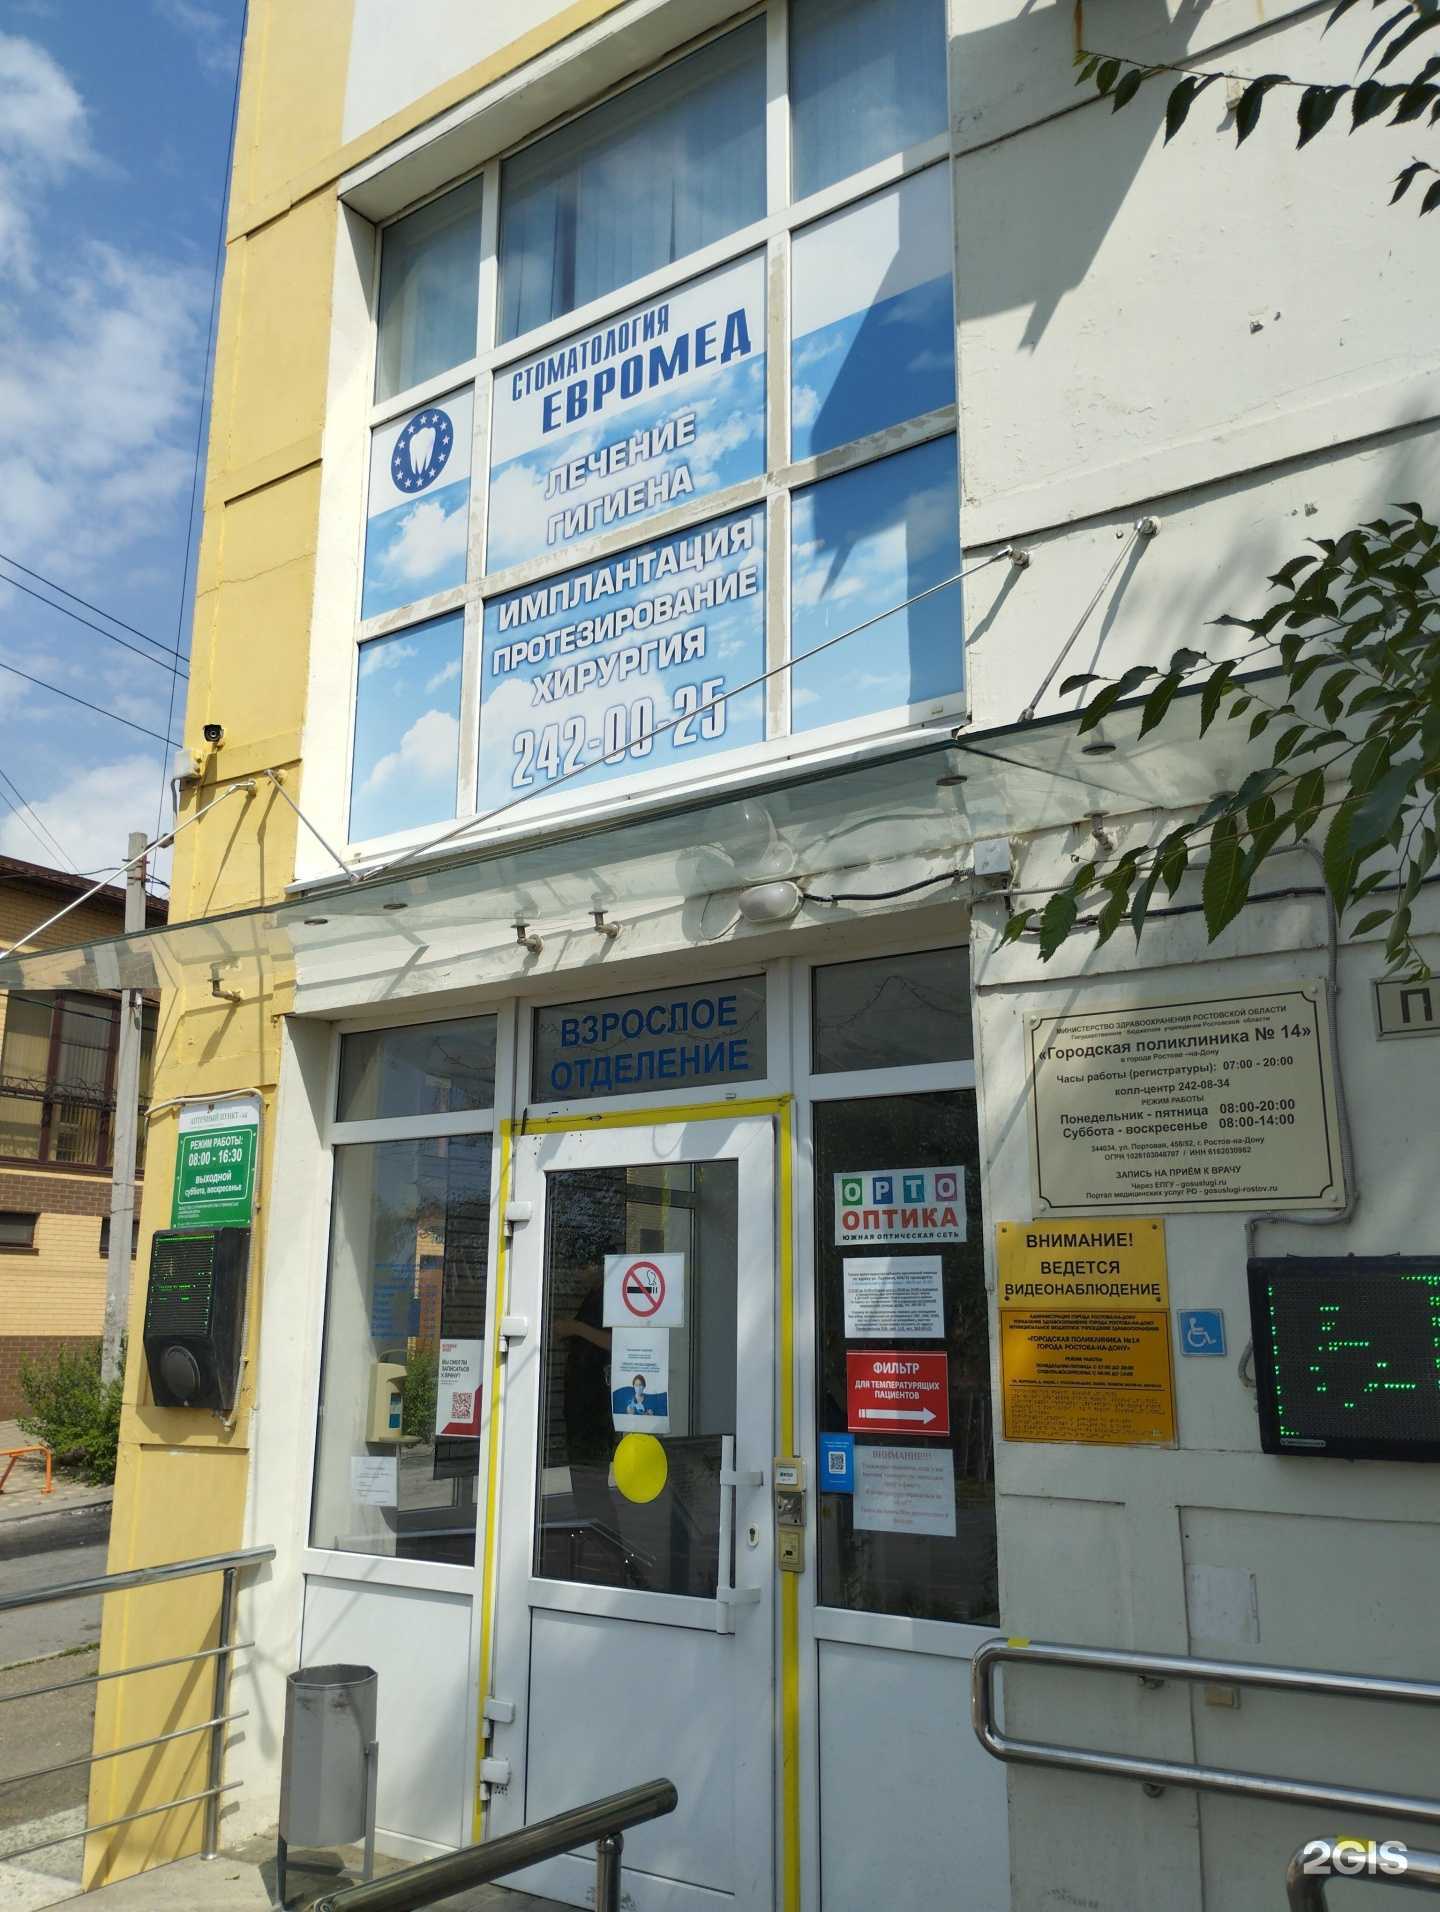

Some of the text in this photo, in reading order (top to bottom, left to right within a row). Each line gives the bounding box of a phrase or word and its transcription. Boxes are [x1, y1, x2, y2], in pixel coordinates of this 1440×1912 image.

[512, 304, 669, 402] СТОМАТОЛОГИЯ
[542, 308, 752, 434] ЕВРОМЕД
[544, 413, 697, 500] ЛЕЧЕНИЕ
[547, 467, 694, 545] ГИГИЕНА
[498, 517, 754, 631] ИМПЛАНТАЦИЯ
[493, 567, 758, 675] ПРОТЕЗИРОВАНИЕ
[532, 627, 706, 706] ХИРУРГИЯ
[512, 678, 726, 788] 242-00-25
[560, 996, 737, 1049] ВЗРОСЛОЕ
[1057, 1005, 1287, 1034] МИНИСТЕРСТВО ЗДРАВООХРАНЕНИЯ РОСТОВСКОЙ ОБЛАСТИ
[1039, 1024, 1312, 1062] «Городская поликлиника № 14»
[550, 1039, 749, 1092] ОТДЕЛЕНИЕ
[1056, 1074, 1084, 1084] Часы
[1087, 1071, 1127, 1083] работы
[1129, 1063, 1217, 1080] (регистратуры):
[1223, 1059, 1253, 1071] 07:00
[1263, 1056, 1294, 1067] 20:00
[1114, 1078, 1230, 1096] колл-центр 242-08-34
[1171, 1095, 1204, 1104] РАБОТЫ
[1060, 1111, 1144, 1125] Понедельник
[1155, 1106, 1209, 1120] пятница
[1219, 1098, 1295, 1114] 08:00-20:00
[1063, 1127, 1115, 1141] Суббота
[1126, 1121, 1209, 1136] воскресенье
[1218, 1114, 1295, 1128] 08:00-14:00
[190, 1136, 243, 1150] РЕЖИМ РАБОТЫ:
[1204, 1137, 1265, 1146] Ростов-на-Дону
[188, 1152, 211, 1166] 08:00
[219, 1148, 242, 1163] 16:30
[1105, 1152, 1125, 1160] ОГРН
[1190, 1148, 1206, 1156] ИНН
[1116, 1170, 1151, 1179] ЗАПИСЬ
[1154, 1168, 1167, 1177] НА
[1169, 1166, 1201, 1176] ПРИЁМ
[1211, 1165, 1241, 1174] ВРАЧУ
[1181, 1179, 1227, 1188] gosuslugi.ru
[1086, 1191, 1112, 1200] Портал
[842, 1207, 959, 1230] ОПТИКА
[842, 1231, 959, 1241] ЮЖНАЯ ОПТИЧЕСКАЯ СЕТЬ
[1026, 1232, 1134, 1249] ВНИМАНИЕ!
[1040, 1260, 1120, 1276] ВЕДЕТСЯ
[1004, 1283, 1161, 1298] ВИДЕОНАБЛЮДЕНИЕ
[872, 1361, 920, 1375] ФИЛЬТР
[855, 1379, 940, 1391] ДЛЯ ТЕМПЕРАТУРЯЩИХ
[874, 1390, 920, 1400] ПАЦИЕНТОВ
